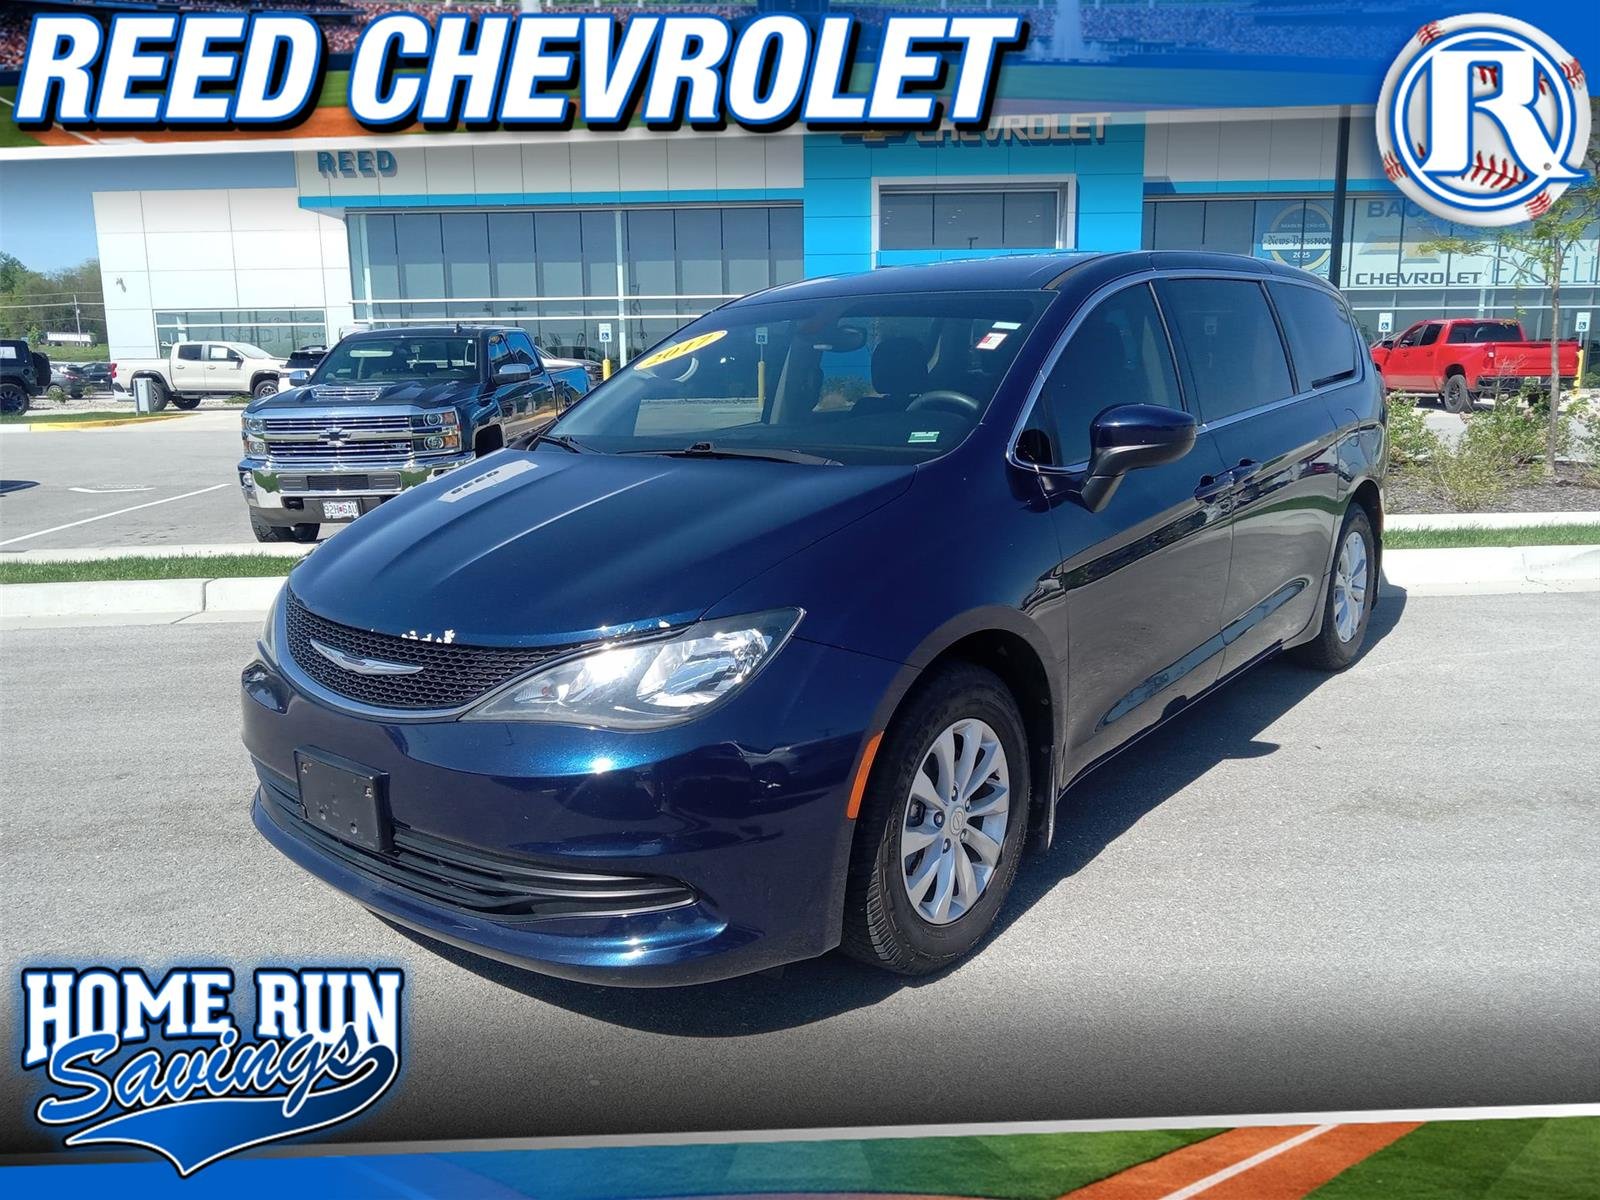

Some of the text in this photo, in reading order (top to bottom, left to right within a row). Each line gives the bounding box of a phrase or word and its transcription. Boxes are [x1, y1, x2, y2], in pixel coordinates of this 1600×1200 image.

[316, 150, 396, 174] REED
[1367, 199, 1426, 218] BAC
[1355, 272, 1482, 285] CHEVROLET
